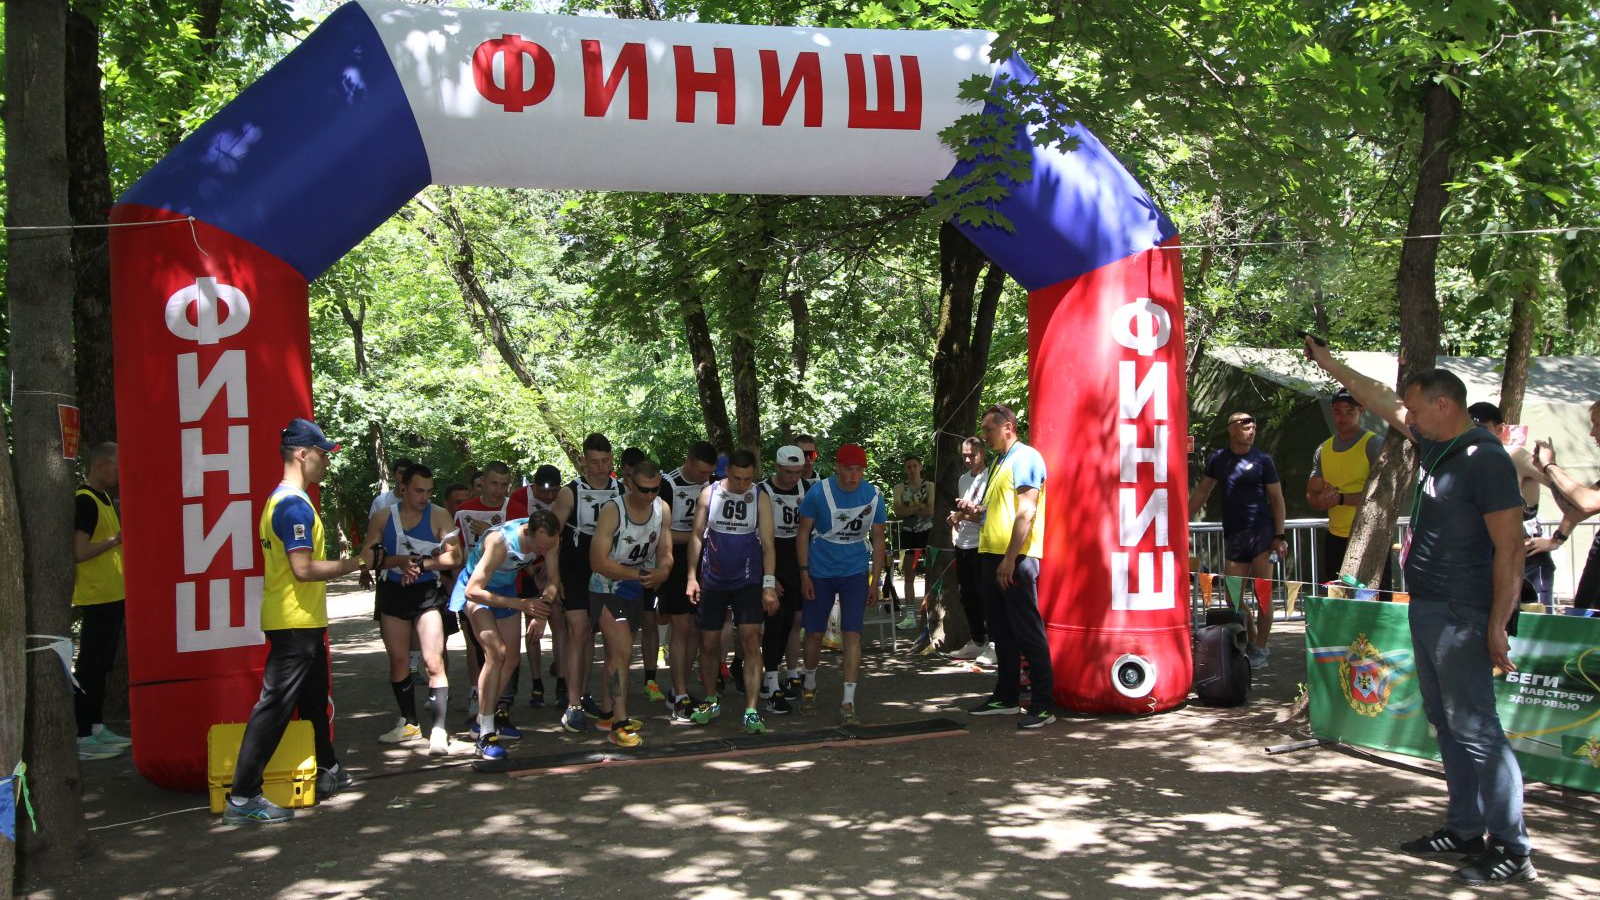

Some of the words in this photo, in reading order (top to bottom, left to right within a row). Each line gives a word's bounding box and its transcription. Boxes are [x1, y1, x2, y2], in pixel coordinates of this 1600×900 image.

[472, 34, 922, 130] ФИНИШ
[165, 276, 266, 652] ФИНИШ
[1111, 297, 1175, 611] ФИНИШ
[723, 500, 747, 520] 69
[783, 505, 800, 525] 68
[628, 542, 649, 561] 44
[1506, 671, 1559, 688] БЕГИ
[1508, 694, 1580, 711] ЗДОРОВЬЮ
[1520, 687, 1594, 703] НАВСТРЕЧУ
